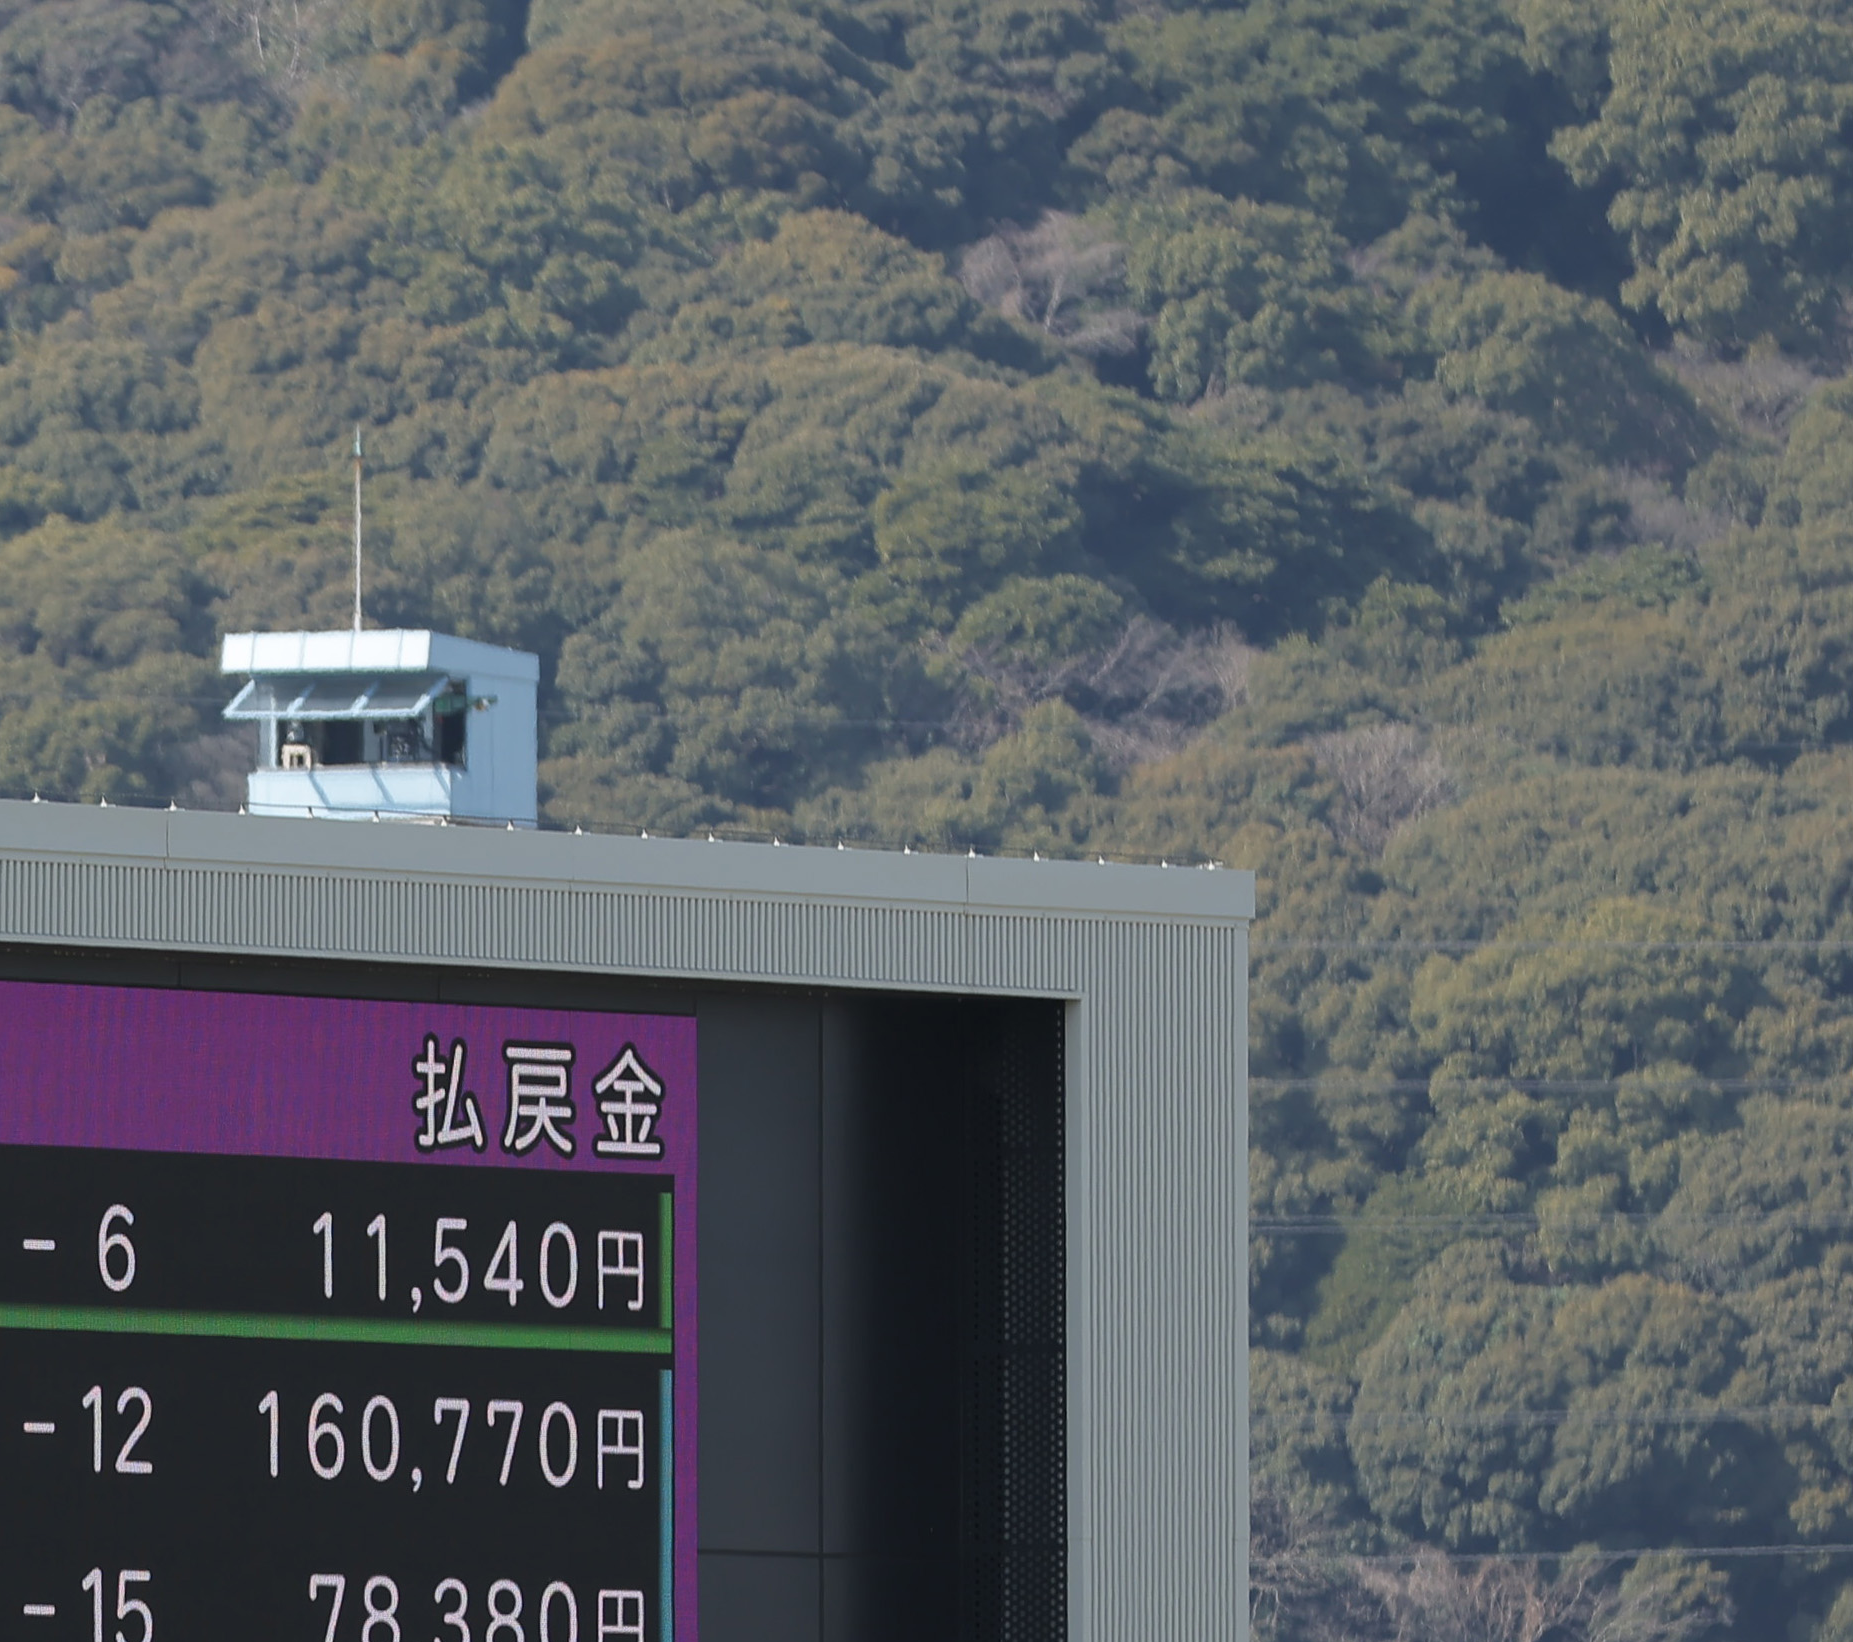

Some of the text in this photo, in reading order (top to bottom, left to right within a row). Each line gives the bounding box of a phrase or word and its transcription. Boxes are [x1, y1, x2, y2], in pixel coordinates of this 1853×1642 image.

[417, 1041, 660, 1153] 払戻金
[99, 1205, 135, 1291] 6
[314, 1213, 643, 1311] 11,540円
[83, 1386, 152, 1473] 12
[259, 1391, 643, 1491] 160,770円
